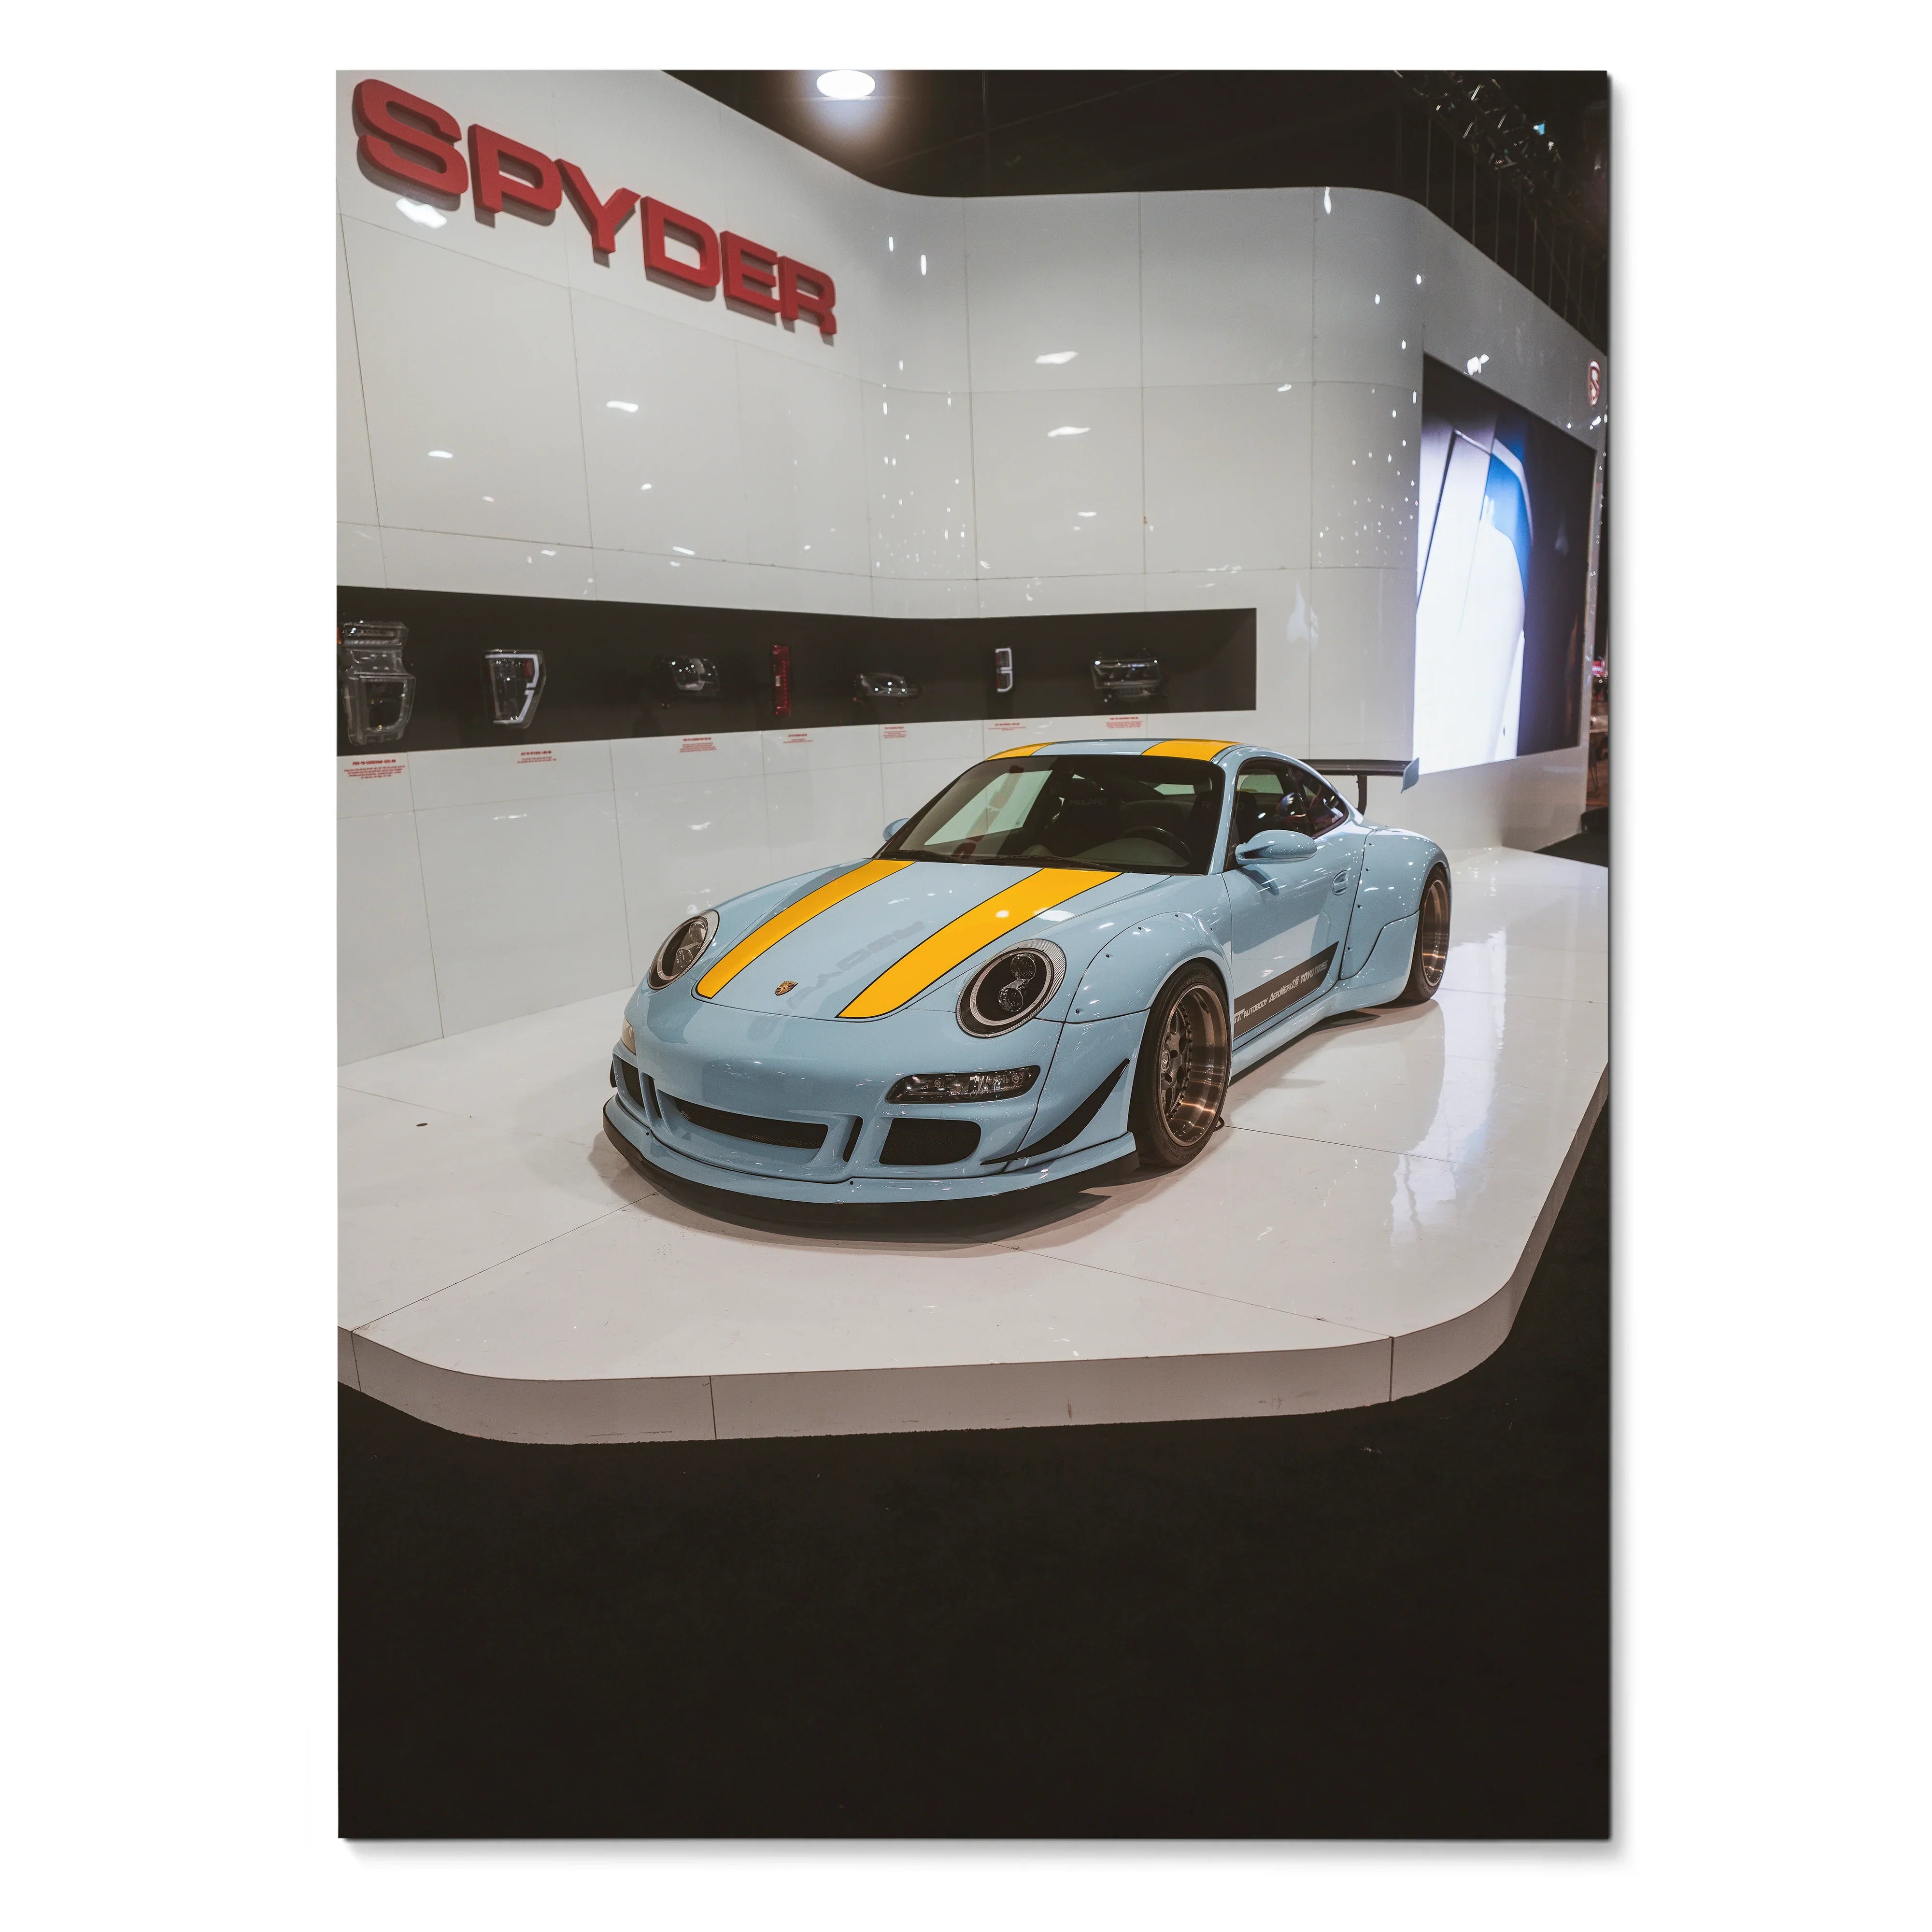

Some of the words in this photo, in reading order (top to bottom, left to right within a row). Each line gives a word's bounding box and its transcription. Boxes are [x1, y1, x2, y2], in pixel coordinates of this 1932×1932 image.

[353, 79, 838, 335] SPYDER
[1244, 997, 1268, 1018] AUTOBODY
[1300, 967, 1315, 983] TOYO
[1314, 960, 1328, 975] TIRES
